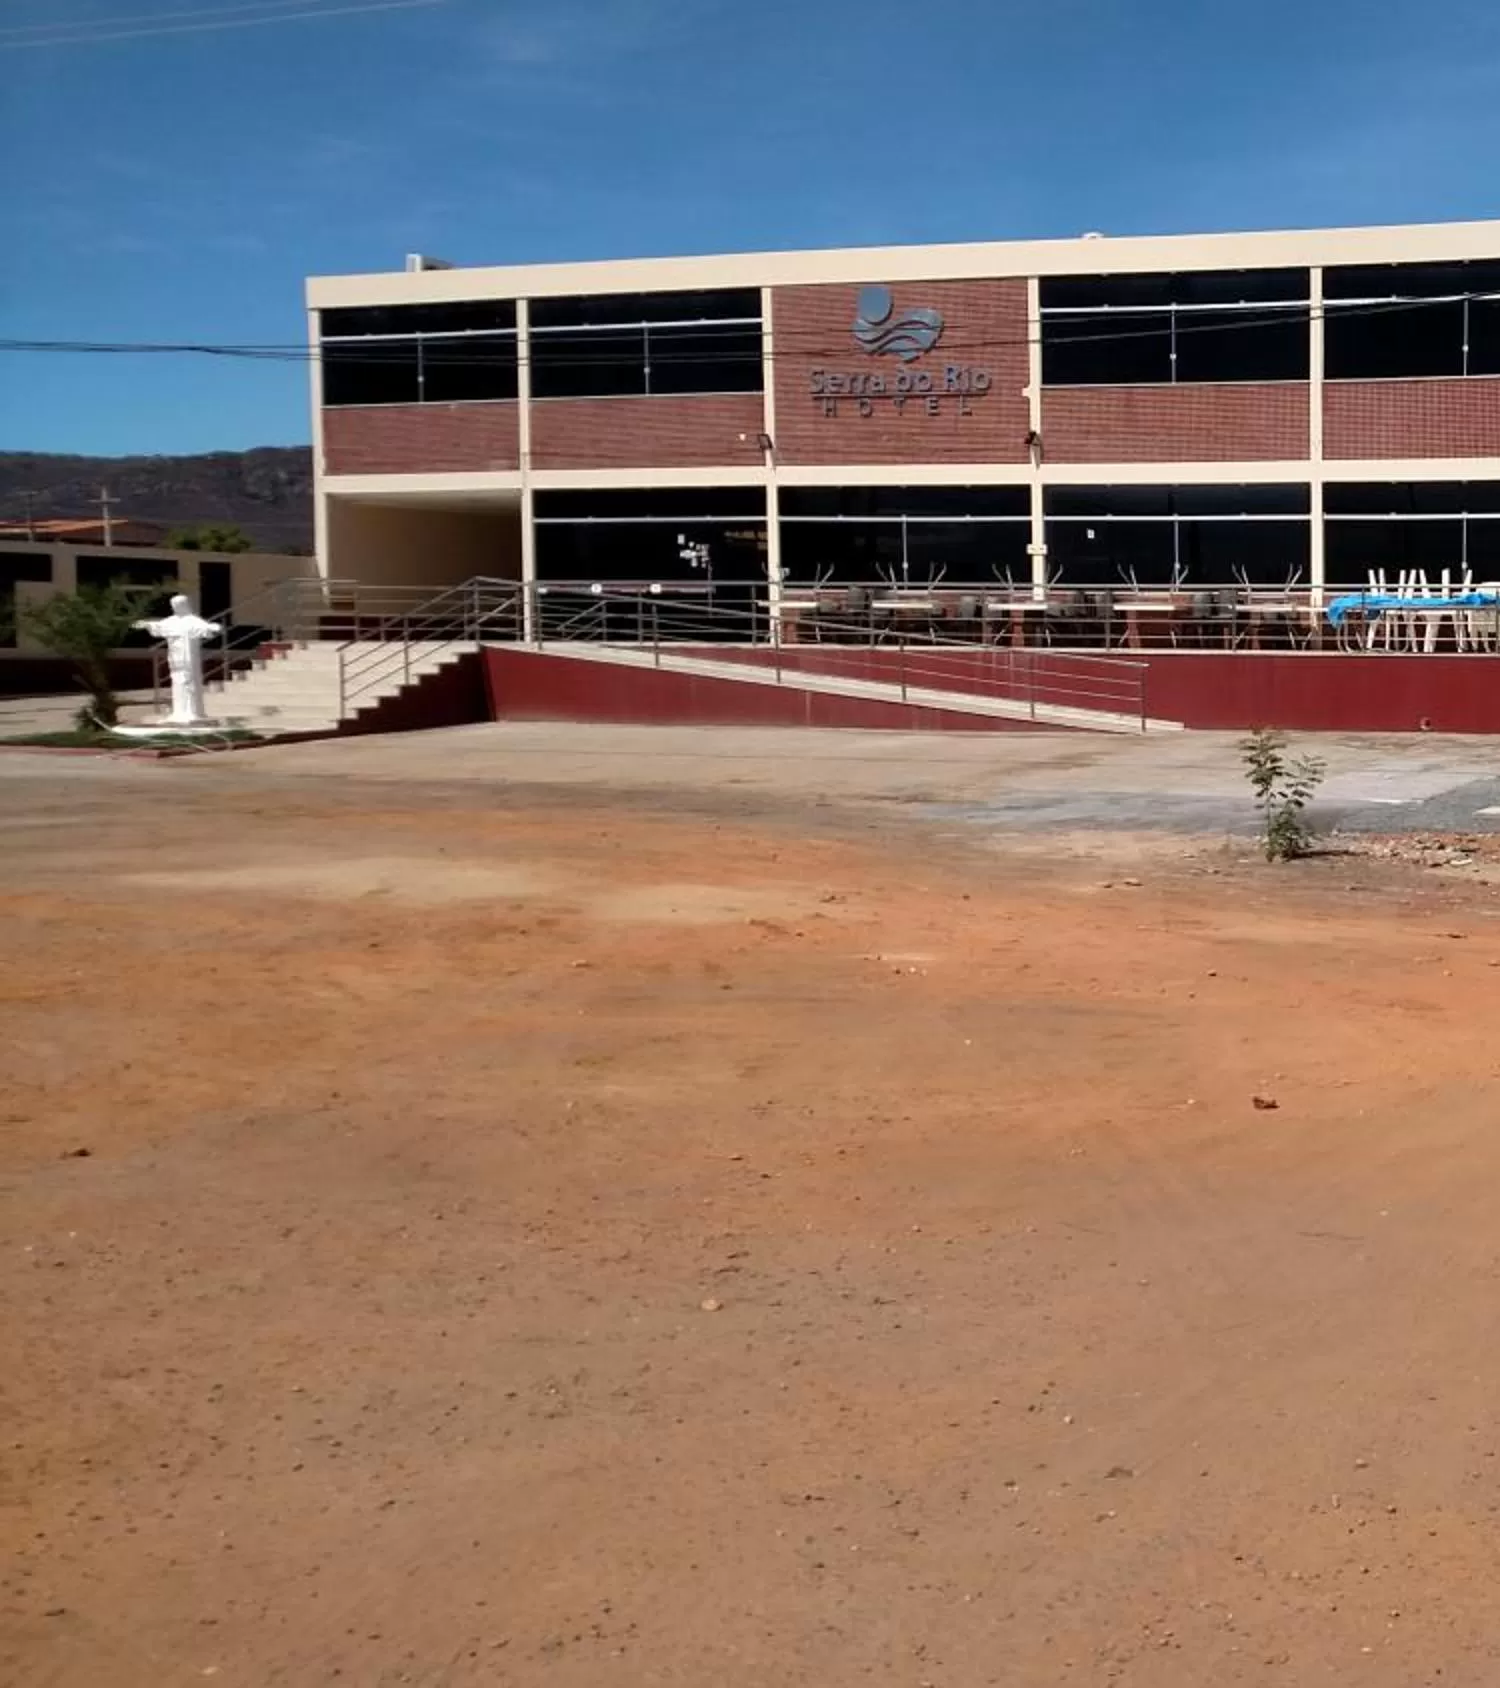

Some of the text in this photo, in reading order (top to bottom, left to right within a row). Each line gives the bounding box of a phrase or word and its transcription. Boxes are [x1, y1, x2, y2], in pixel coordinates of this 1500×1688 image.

[810, 367, 886, 393] Serra
[944, 364, 992, 391] Rio
[823, 397, 973, 417] HOTEL
